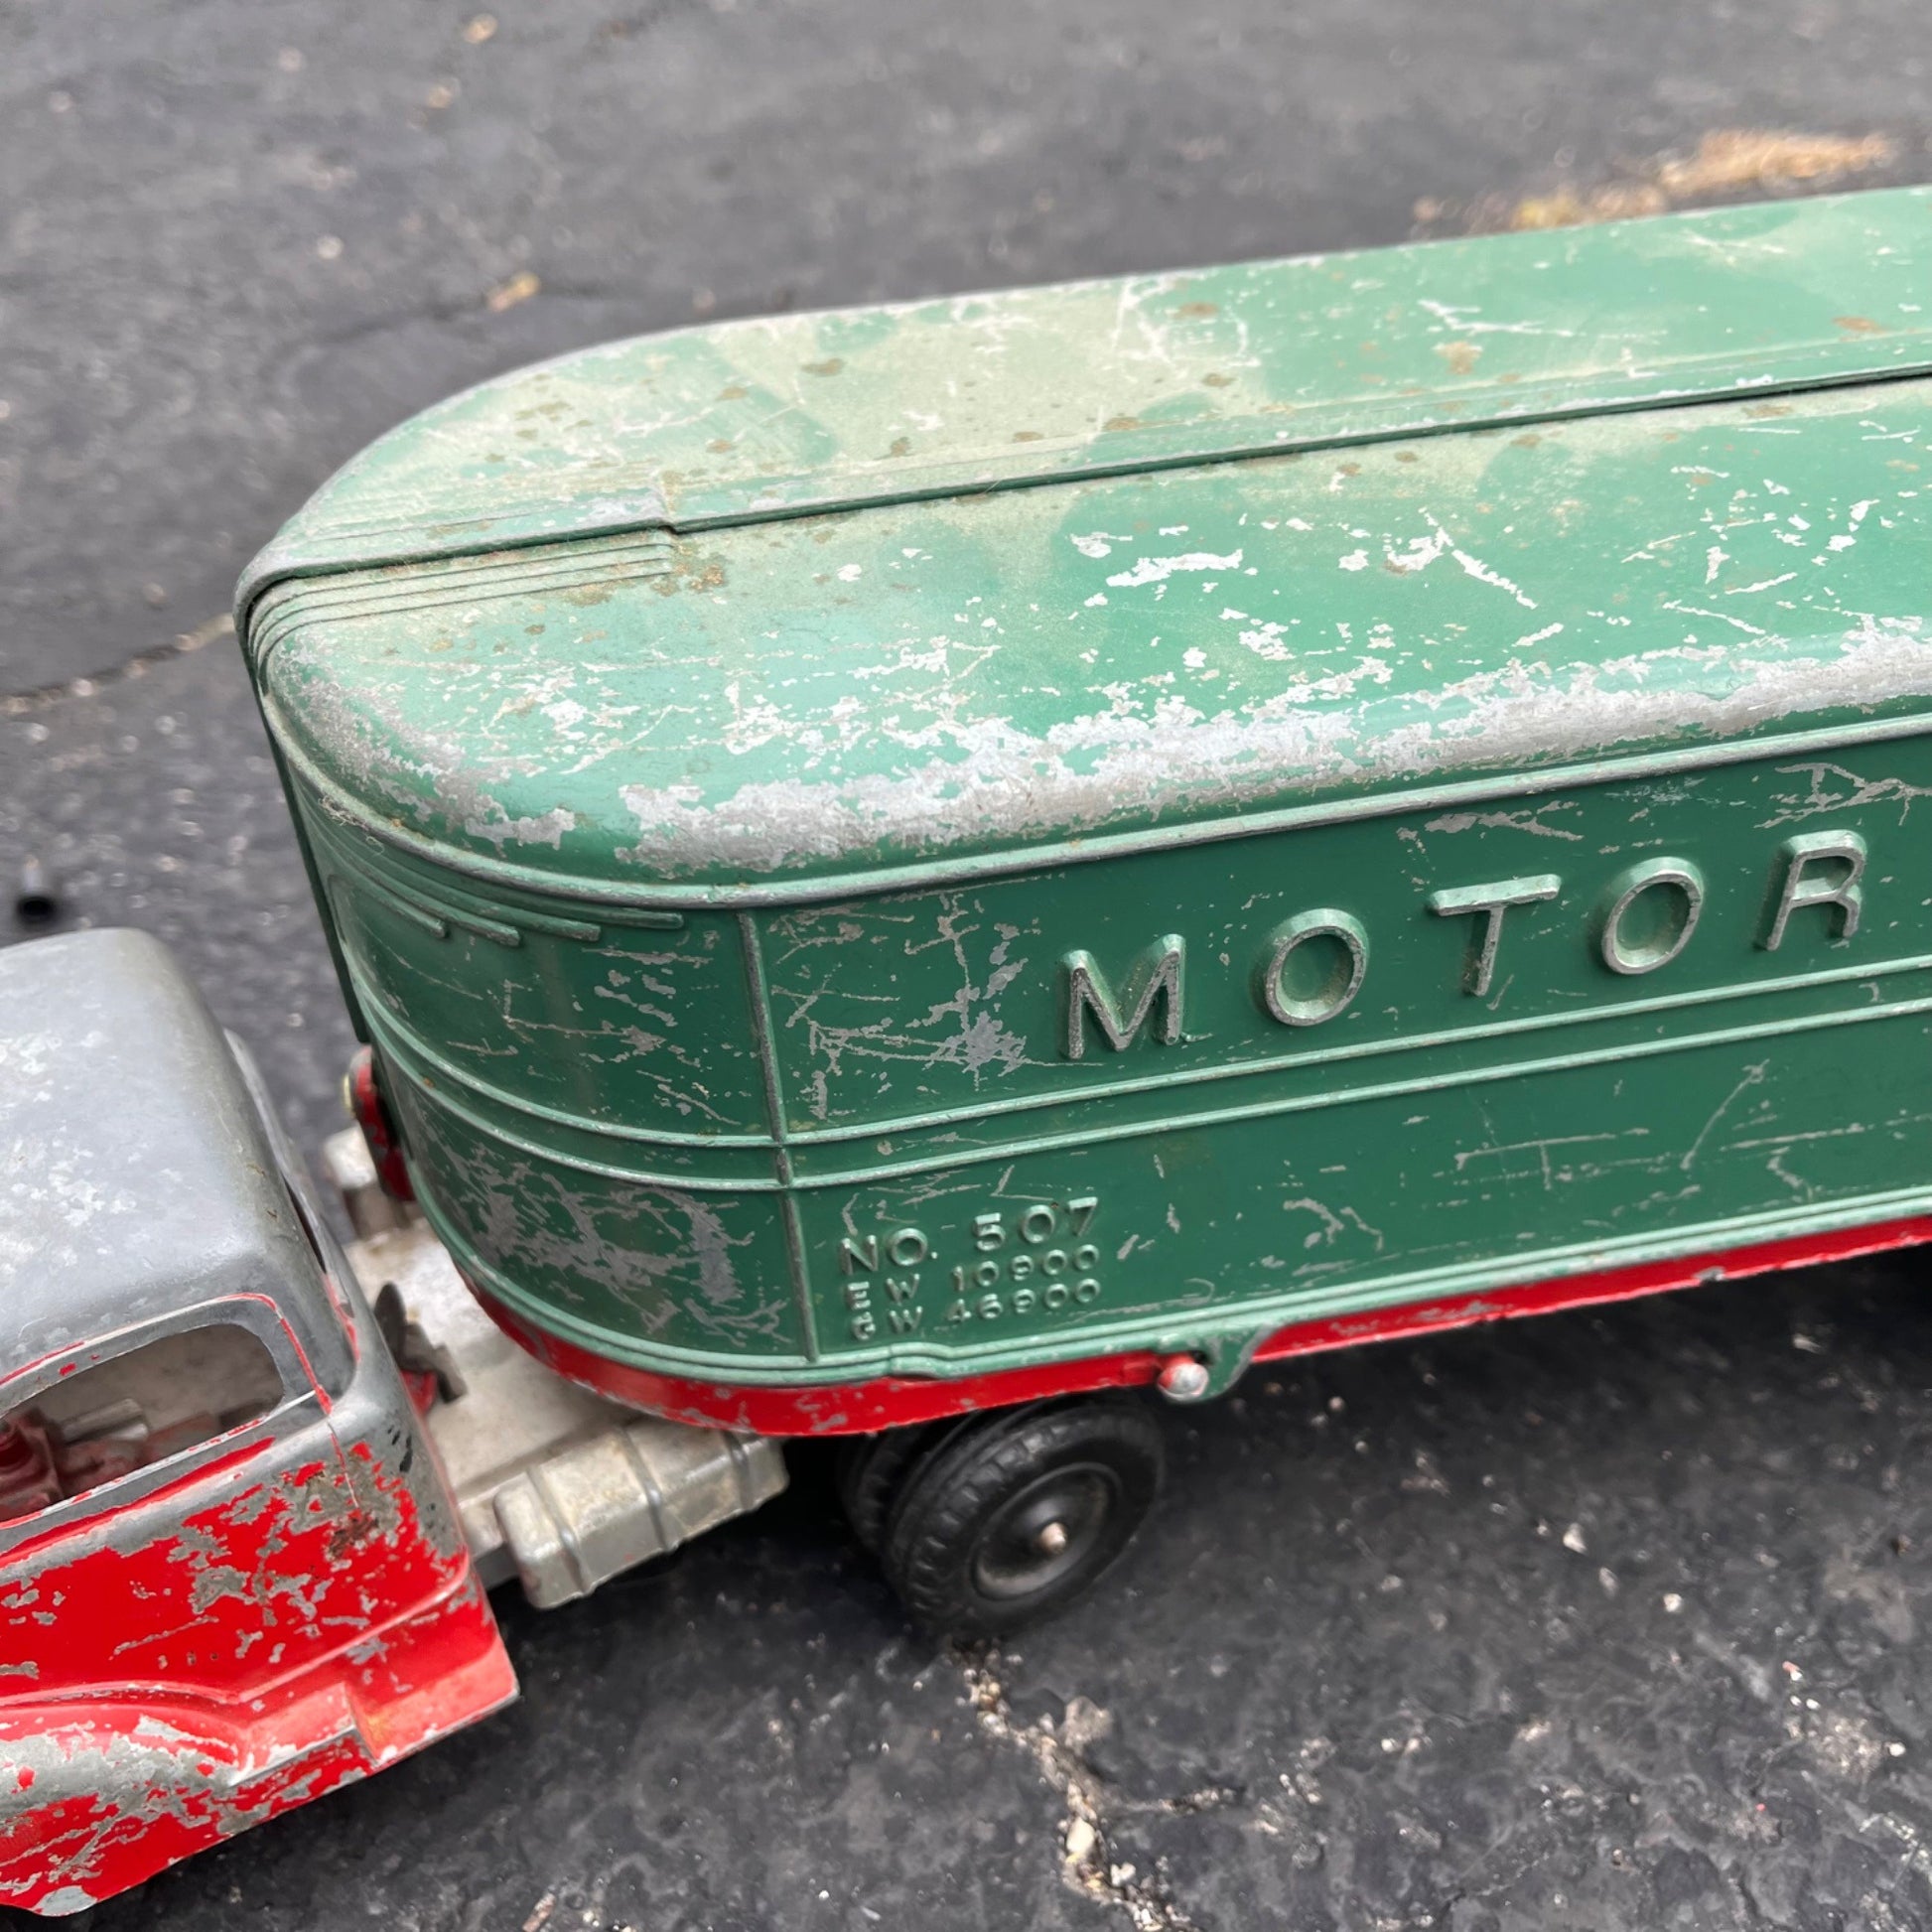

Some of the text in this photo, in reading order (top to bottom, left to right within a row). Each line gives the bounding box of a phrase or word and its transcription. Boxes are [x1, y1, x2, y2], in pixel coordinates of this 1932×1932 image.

[1061, 828, 1868, 1060] MOTOR
[841, 1195, 1098, 1275] NO. 507
